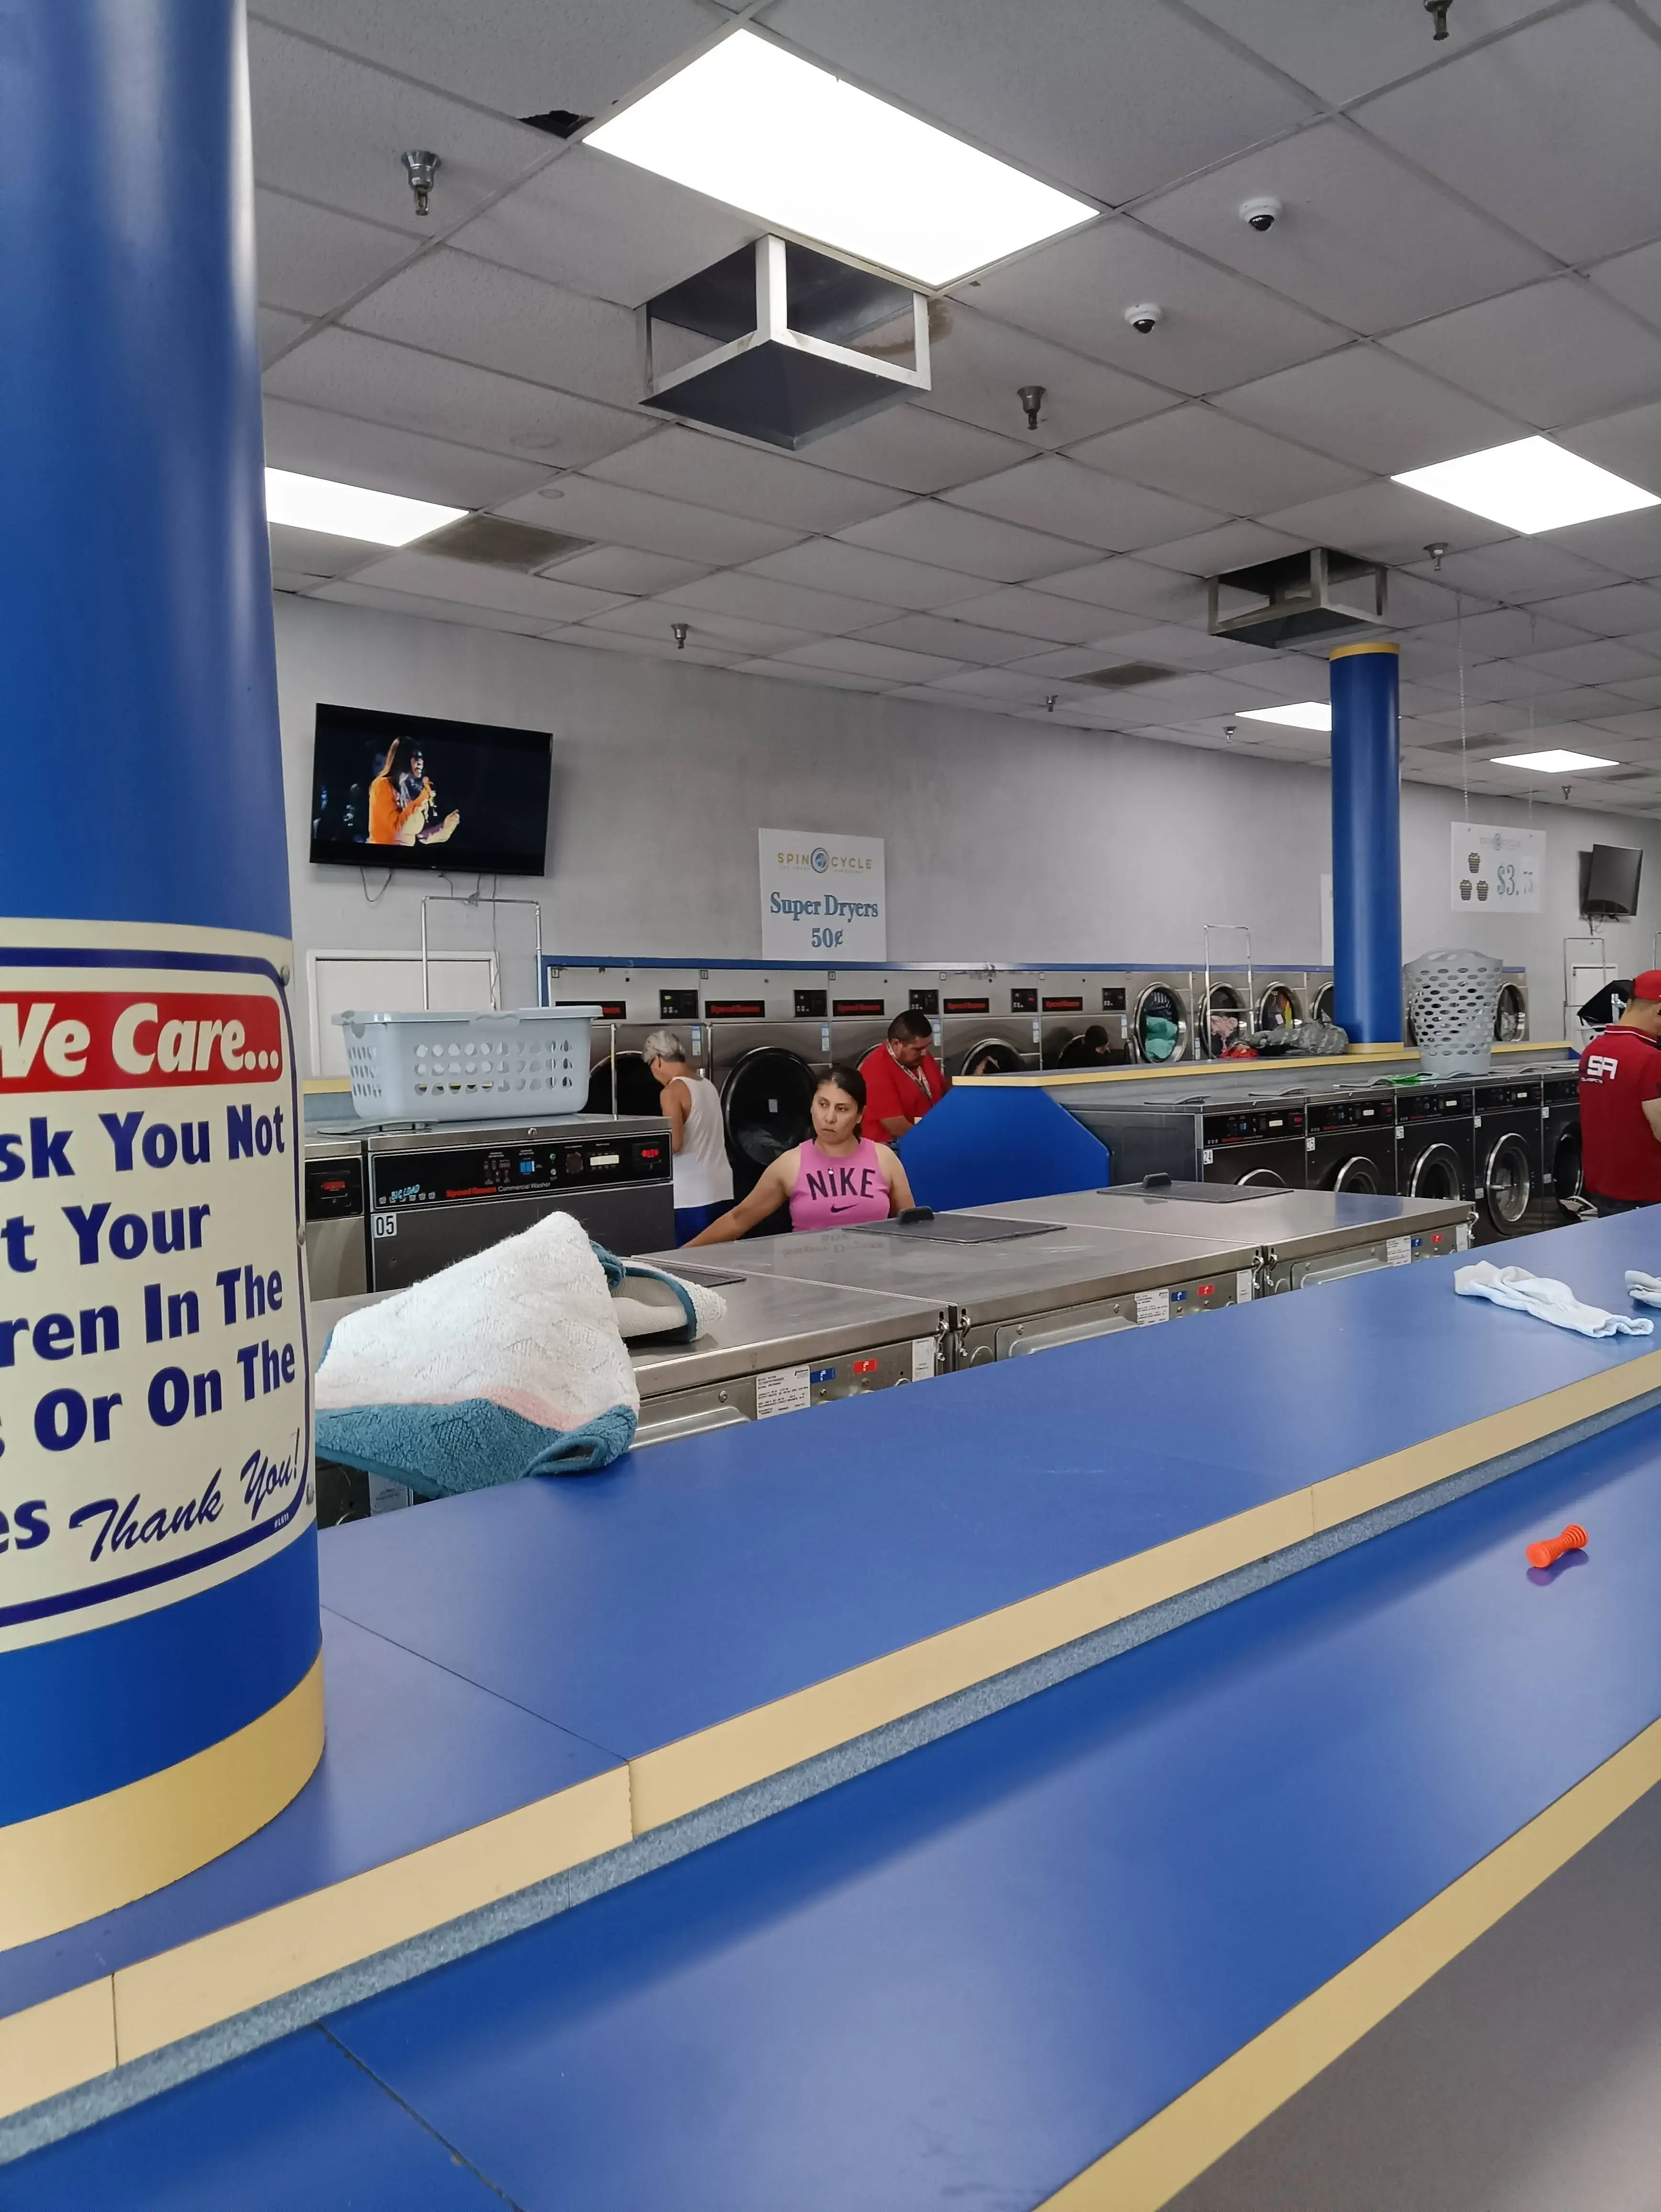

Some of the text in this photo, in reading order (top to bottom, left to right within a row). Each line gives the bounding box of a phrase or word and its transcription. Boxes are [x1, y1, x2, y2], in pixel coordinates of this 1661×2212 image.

[778, 852, 872, 869] SPIN CYCLE
[770, 892, 878, 922] Super Dryers
[811, 928, 843, 948] 50¢
[112, 1003, 279, 1074] Care...
[99, 1111, 210, 1172] You
[226, 1104, 285, 1160] Not
[806, 1167, 875, 1201] NIKE
[61, 1202, 211, 1265] Your
[376, 1215, 395, 1236] 05
[144, 1283, 200, 1344] In
[216, 1264, 283, 1326] The
[34, 1388, 123, 1451] Or
[148, 1366, 222, 1427] On
[237, 1339, 295, 1402] The
[68, 1468, 224, 1562] Thank
[240, 1427, 300, 1521] You!
